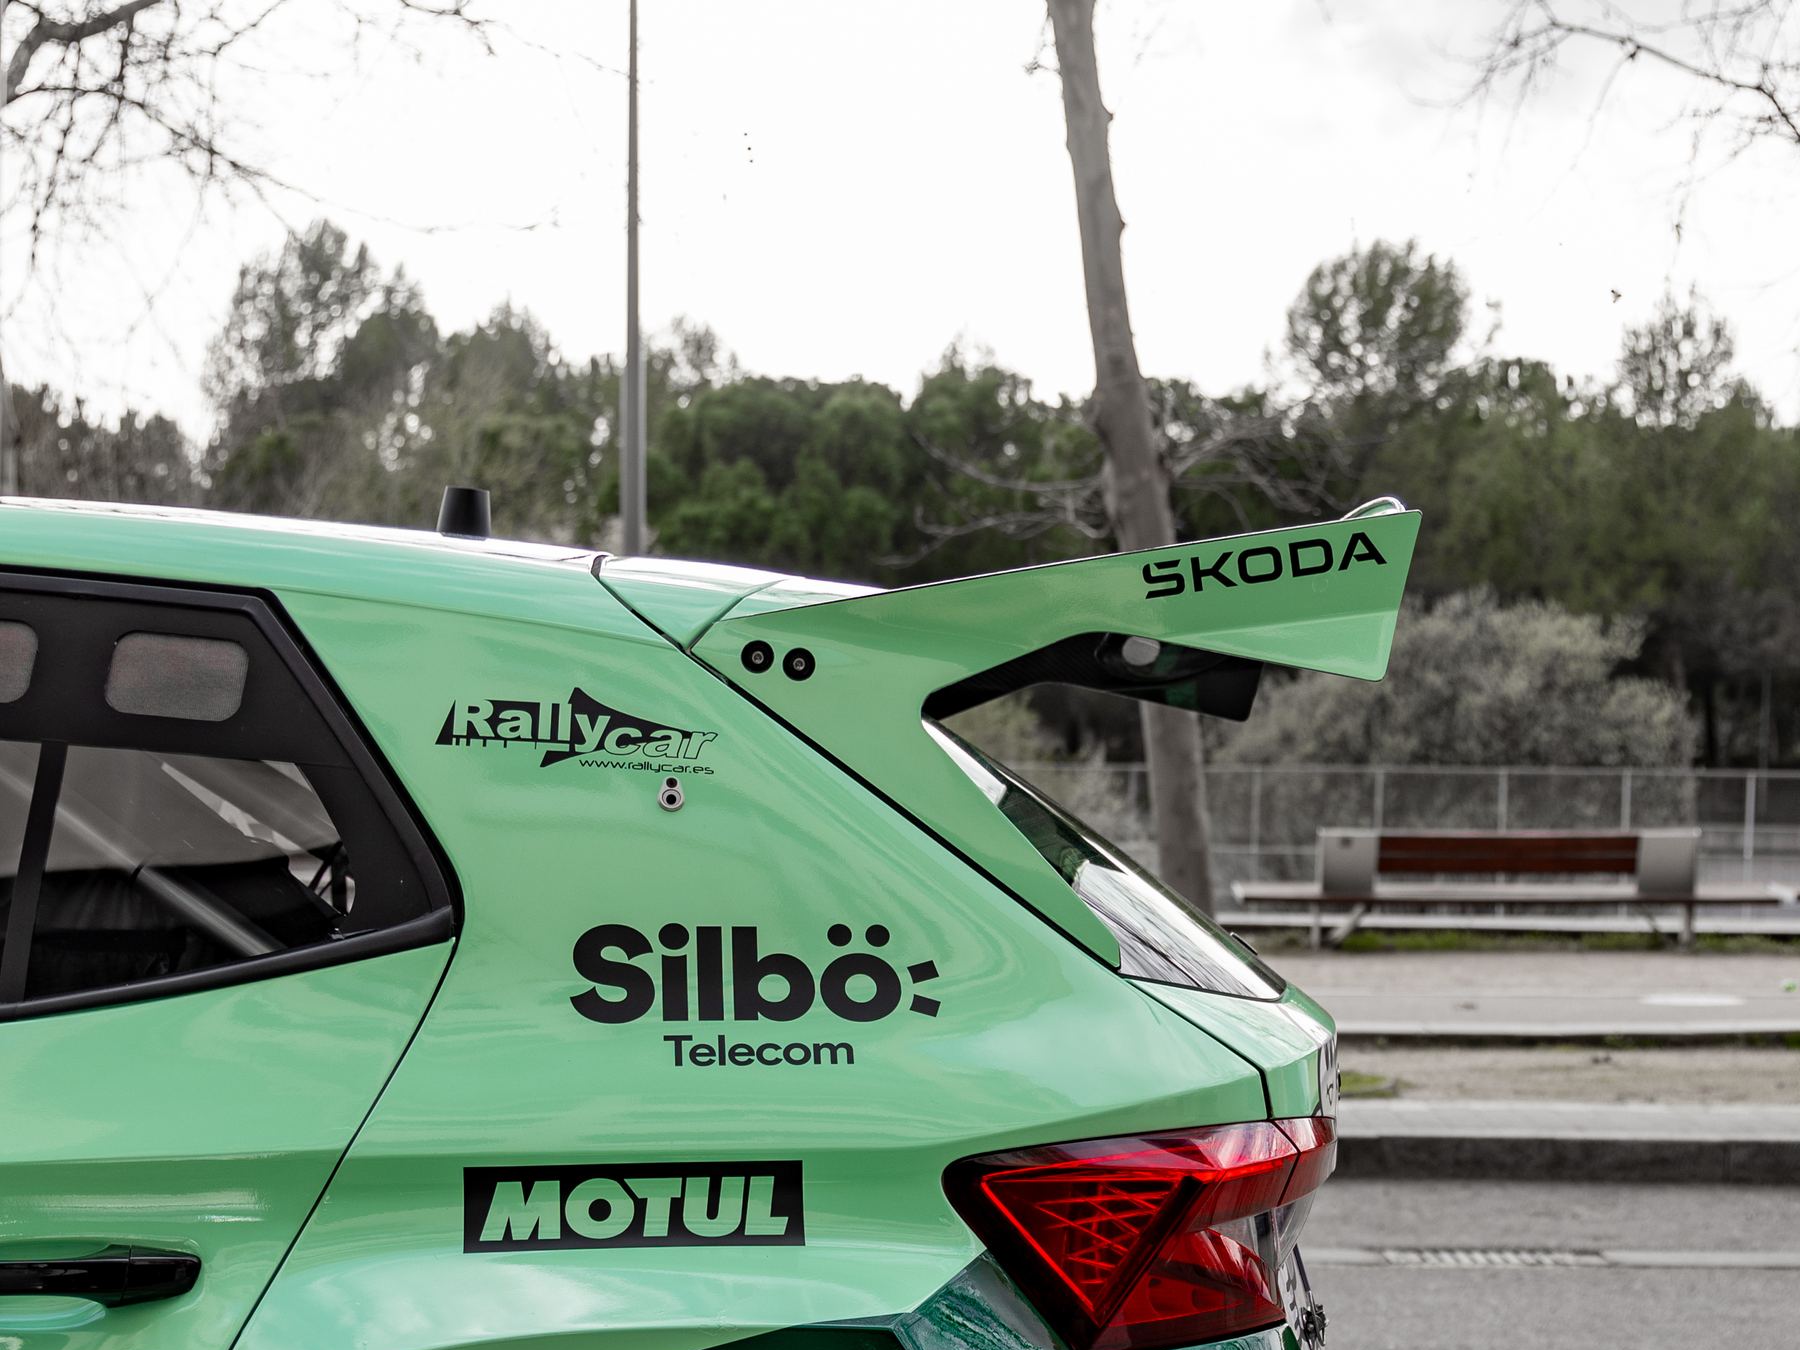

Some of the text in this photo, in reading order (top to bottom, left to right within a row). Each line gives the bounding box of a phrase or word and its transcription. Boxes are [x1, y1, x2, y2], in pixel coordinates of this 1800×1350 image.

[449, 697, 719, 760] Rallycar
[579, 759, 714, 776] www.rallycar.es
[663, 1034, 855, 1067] Telecom
[478, 1175, 790, 1242] MOTUL
